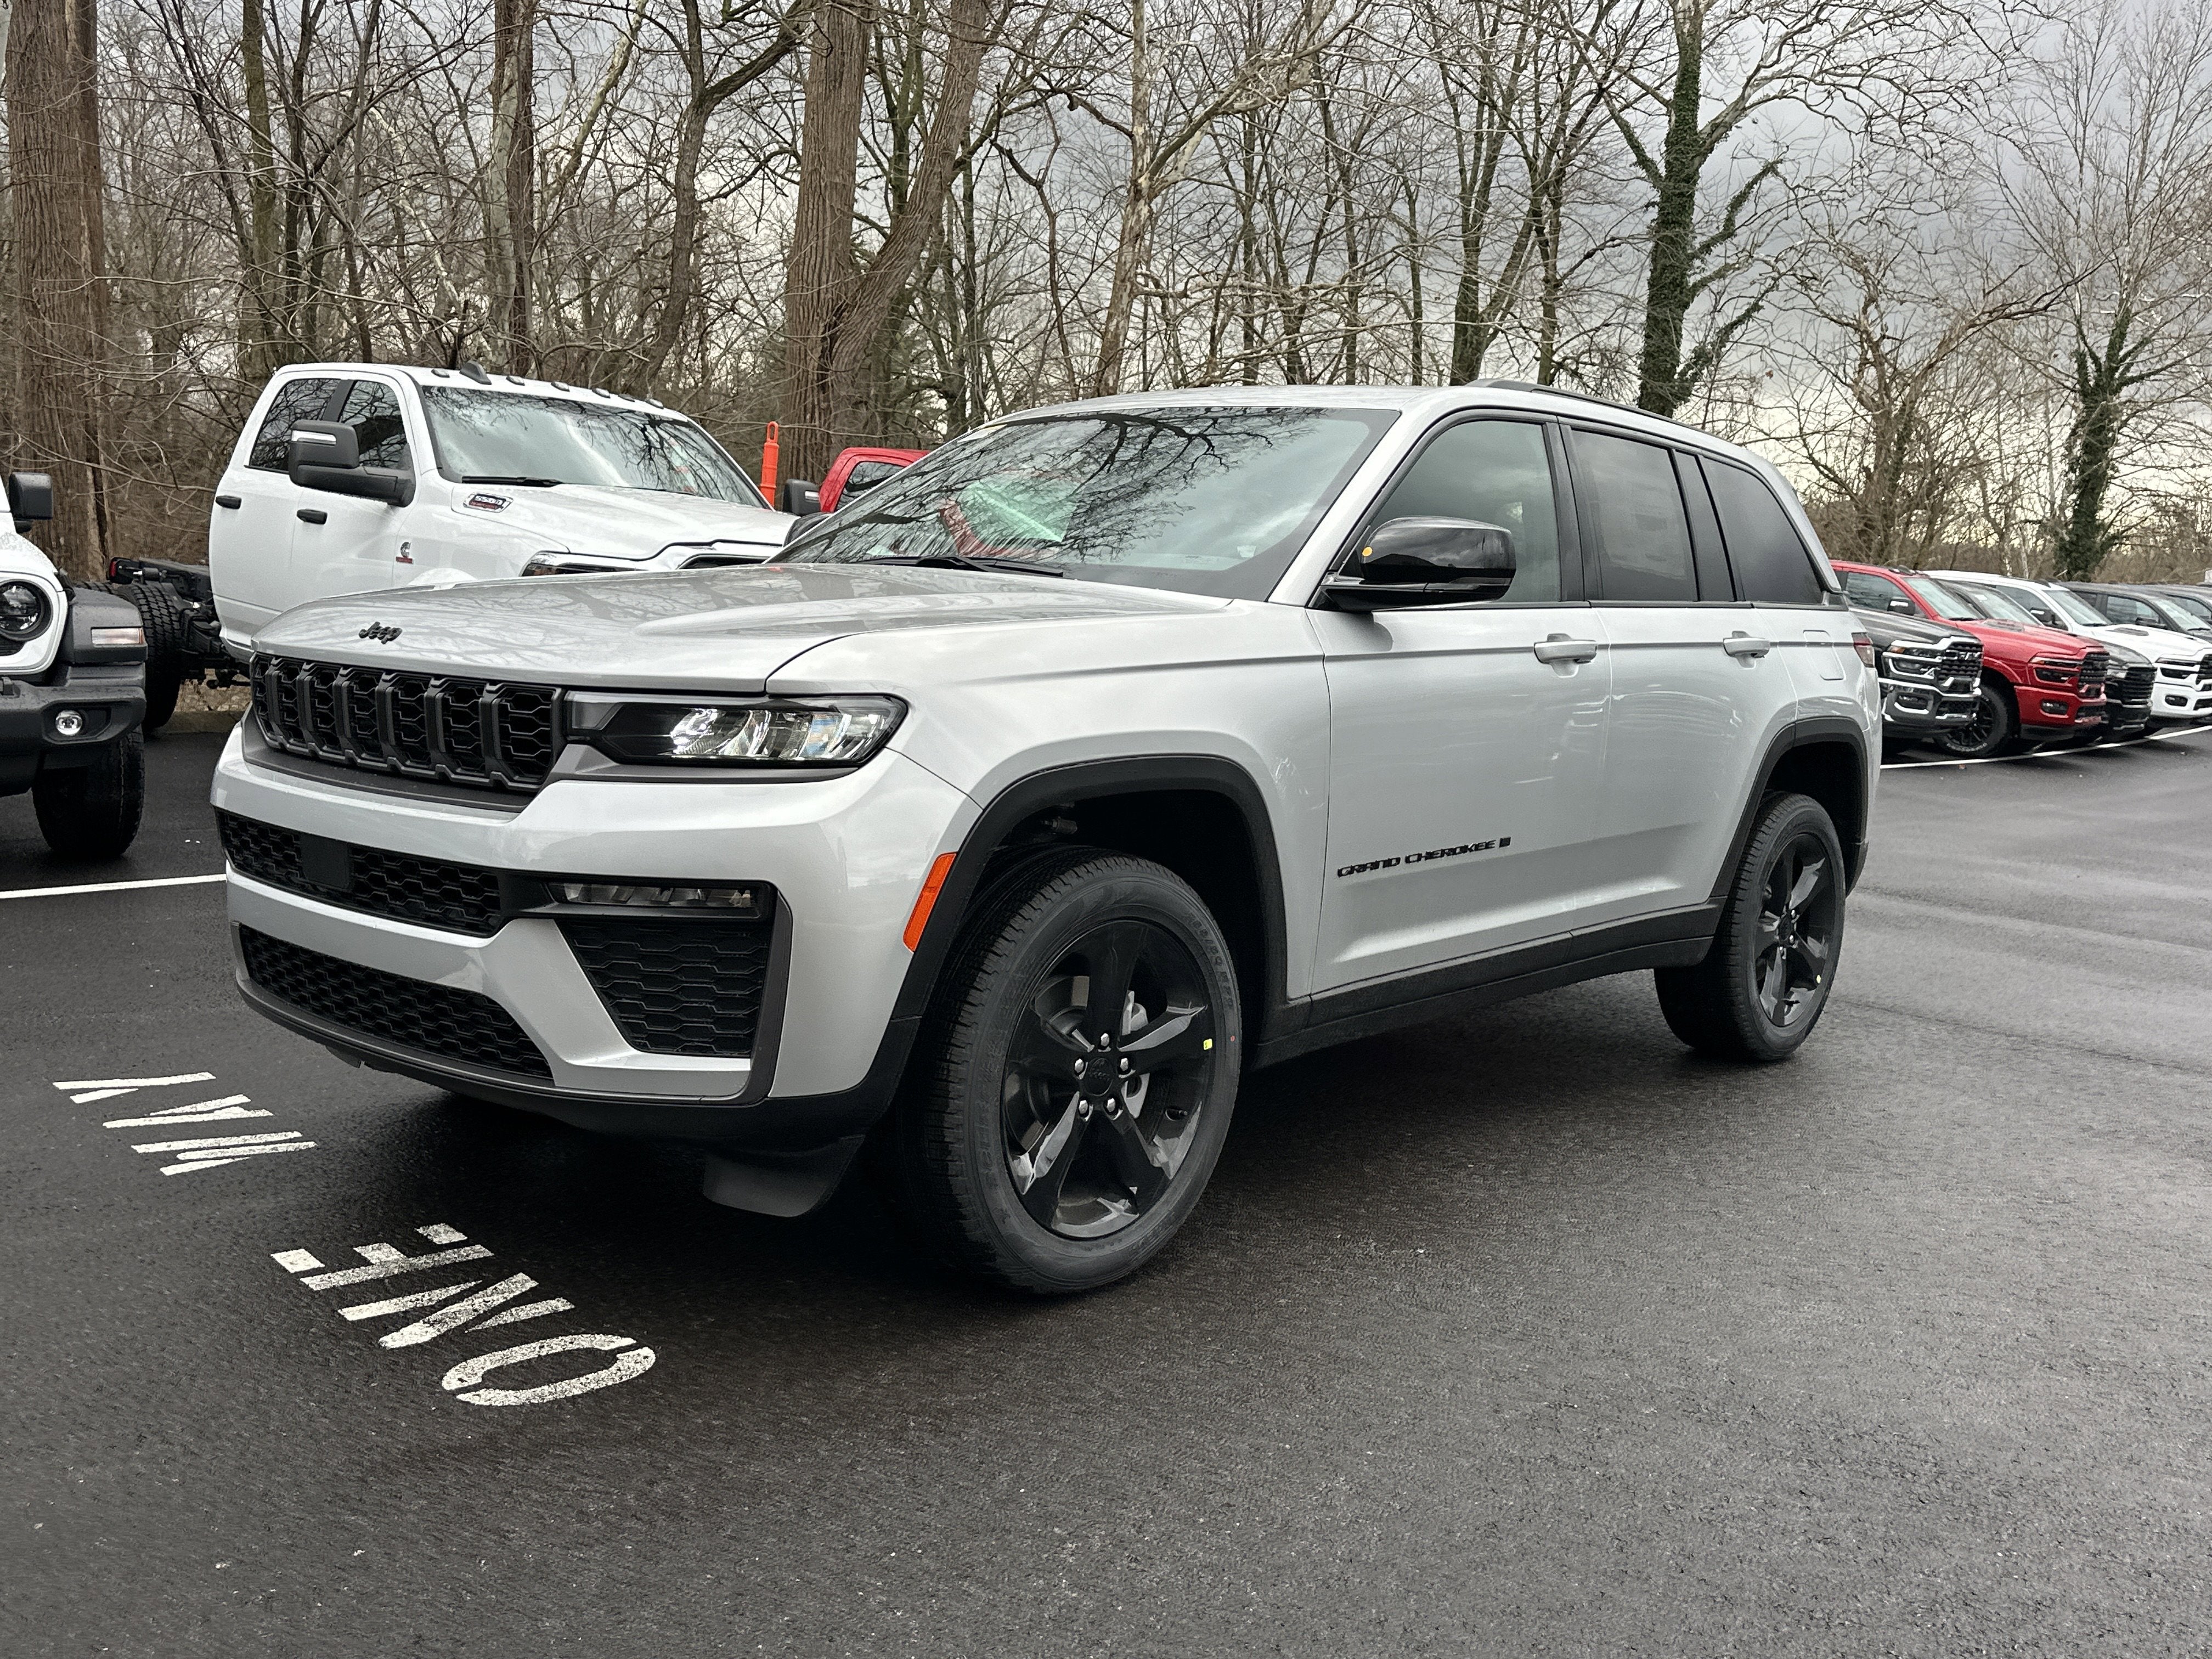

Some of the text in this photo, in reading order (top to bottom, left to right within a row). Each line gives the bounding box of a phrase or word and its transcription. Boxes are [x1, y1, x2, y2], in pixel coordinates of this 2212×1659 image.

[358, 621, 403, 645] Jeep
[1337, 839, 1497, 878] GRAND CHEROKEE
[53, 1071, 657, 1407] ONE WAY
